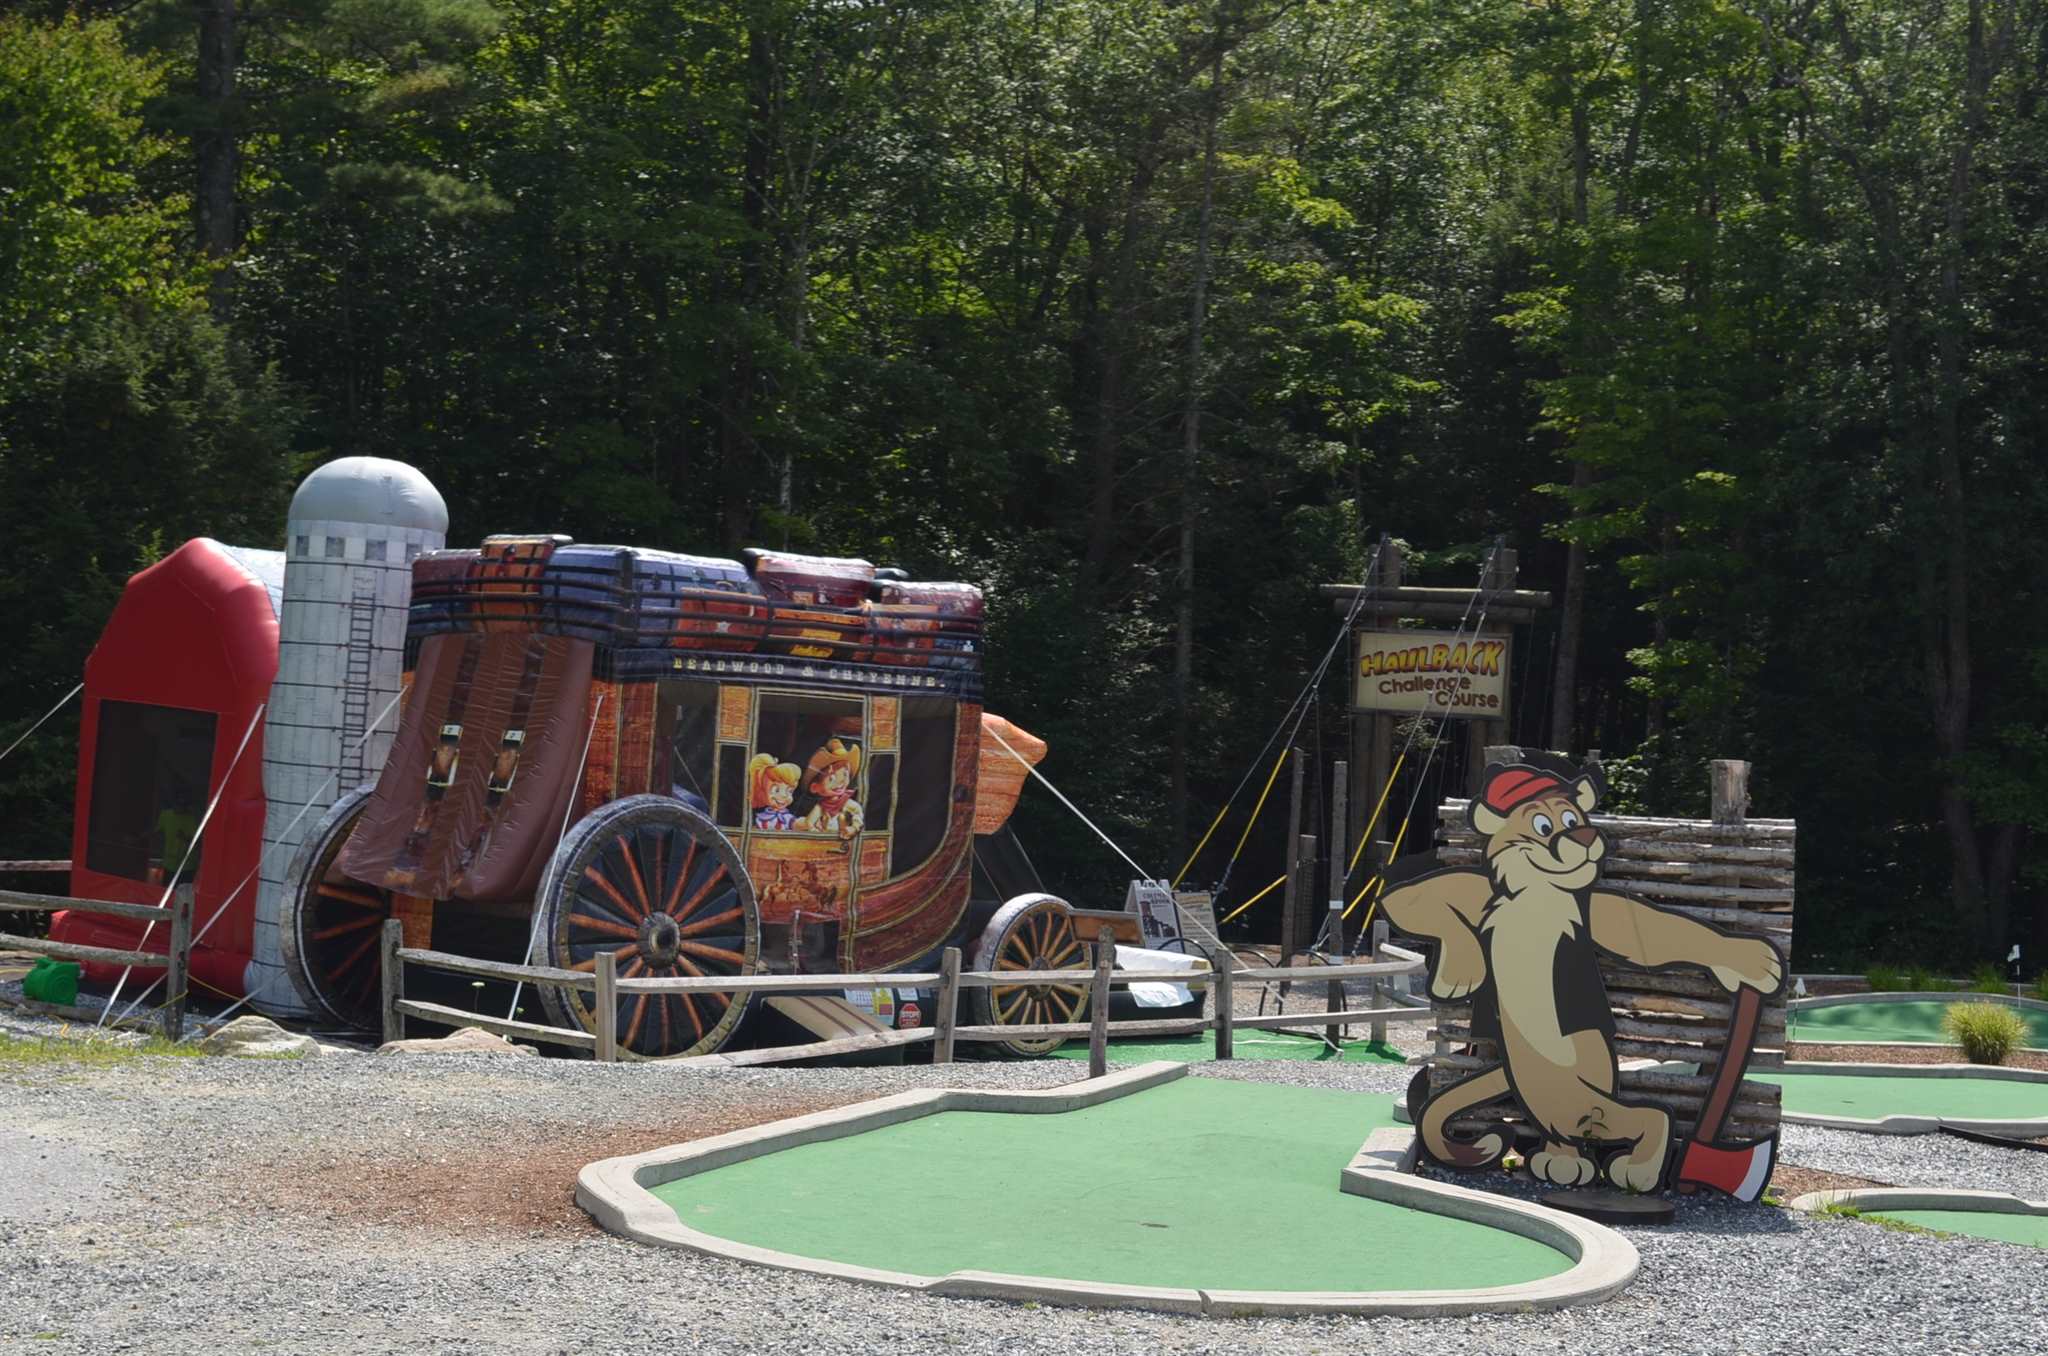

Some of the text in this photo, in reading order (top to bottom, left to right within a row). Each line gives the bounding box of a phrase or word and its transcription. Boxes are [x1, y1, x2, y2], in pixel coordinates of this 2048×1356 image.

[673, 657, 785, 675] DEADWOOD
[801, 666, 815, 677] &
[1360, 641, 1504, 677] HAULBACK
[1378, 675, 1472, 694] Challenge
[1435, 690, 1499, 708] Course
